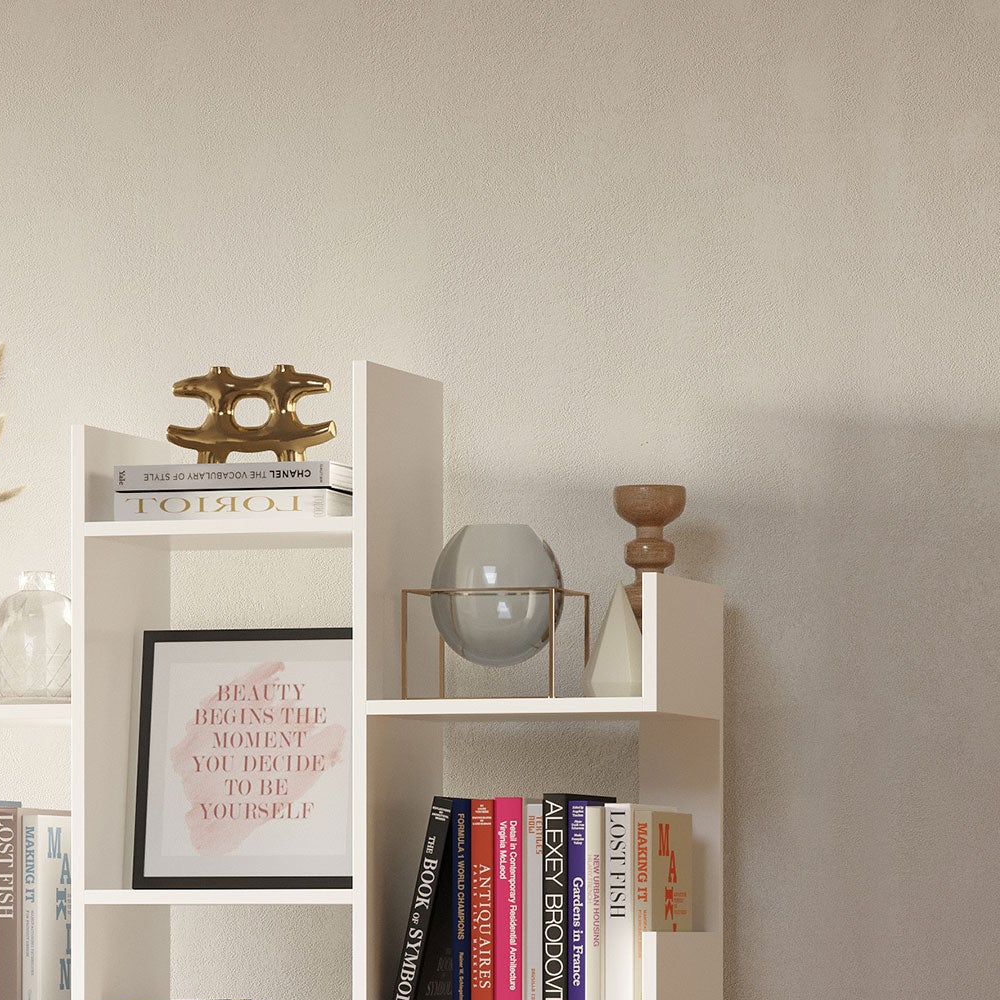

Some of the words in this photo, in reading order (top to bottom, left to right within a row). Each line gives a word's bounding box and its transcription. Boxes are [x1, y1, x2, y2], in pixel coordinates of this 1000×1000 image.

[118, 471, 126, 486] Yale
[143, 473, 169, 481] STYLE
[187, 470, 248, 480] VOCABULARY
[249, 470, 267, 479] THE
[270, 469, 311, 479] CHANEL
[217, 684, 306, 701] BEAUTY
[194, 708, 274, 726] BEGINS
[280, 707, 327, 724] THE
[211, 731, 307, 749] MOMENT
[191, 755, 235, 773] YOU
[243, 755, 325, 772] DECIDE
[224, 779, 252, 796] TO
[260, 779, 288, 796] BE
[200, 802, 315, 820] YOURSELF
[457, 813, 465, 853] FORMULA
[498, 820, 507, 848] Virginia
[509, 820, 517, 841] Detail
[609, 809, 626, 865] LOST
[25, 826, 35, 884] MAKING
[425, 836, 437, 854] THE
[545, 800, 563, 887] ALEXEY
[637, 822, 648, 883] MAKING
[457, 860, 465, 891] WORLD
[498, 849, 507, 880] McLeod
[414, 857, 439, 910] BOOK
[509, 851, 517, 903] Contemporary
[25, 888, 35, 903] IT
[572, 877, 583, 928] Gardens
[609, 872, 626, 918] FISH
[637, 887, 648, 903] IT
[411, 912, 421, 925] OF
[457, 892, 465, 940] CHAMPIONS
[478, 864, 491, 989] ANTIQUAIRES
[509, 905, 517, 945] Residential
[572, 929, 583, 941] in
[509, 946, 517, 991] Architecture
[572, 944, 583, 986] France
